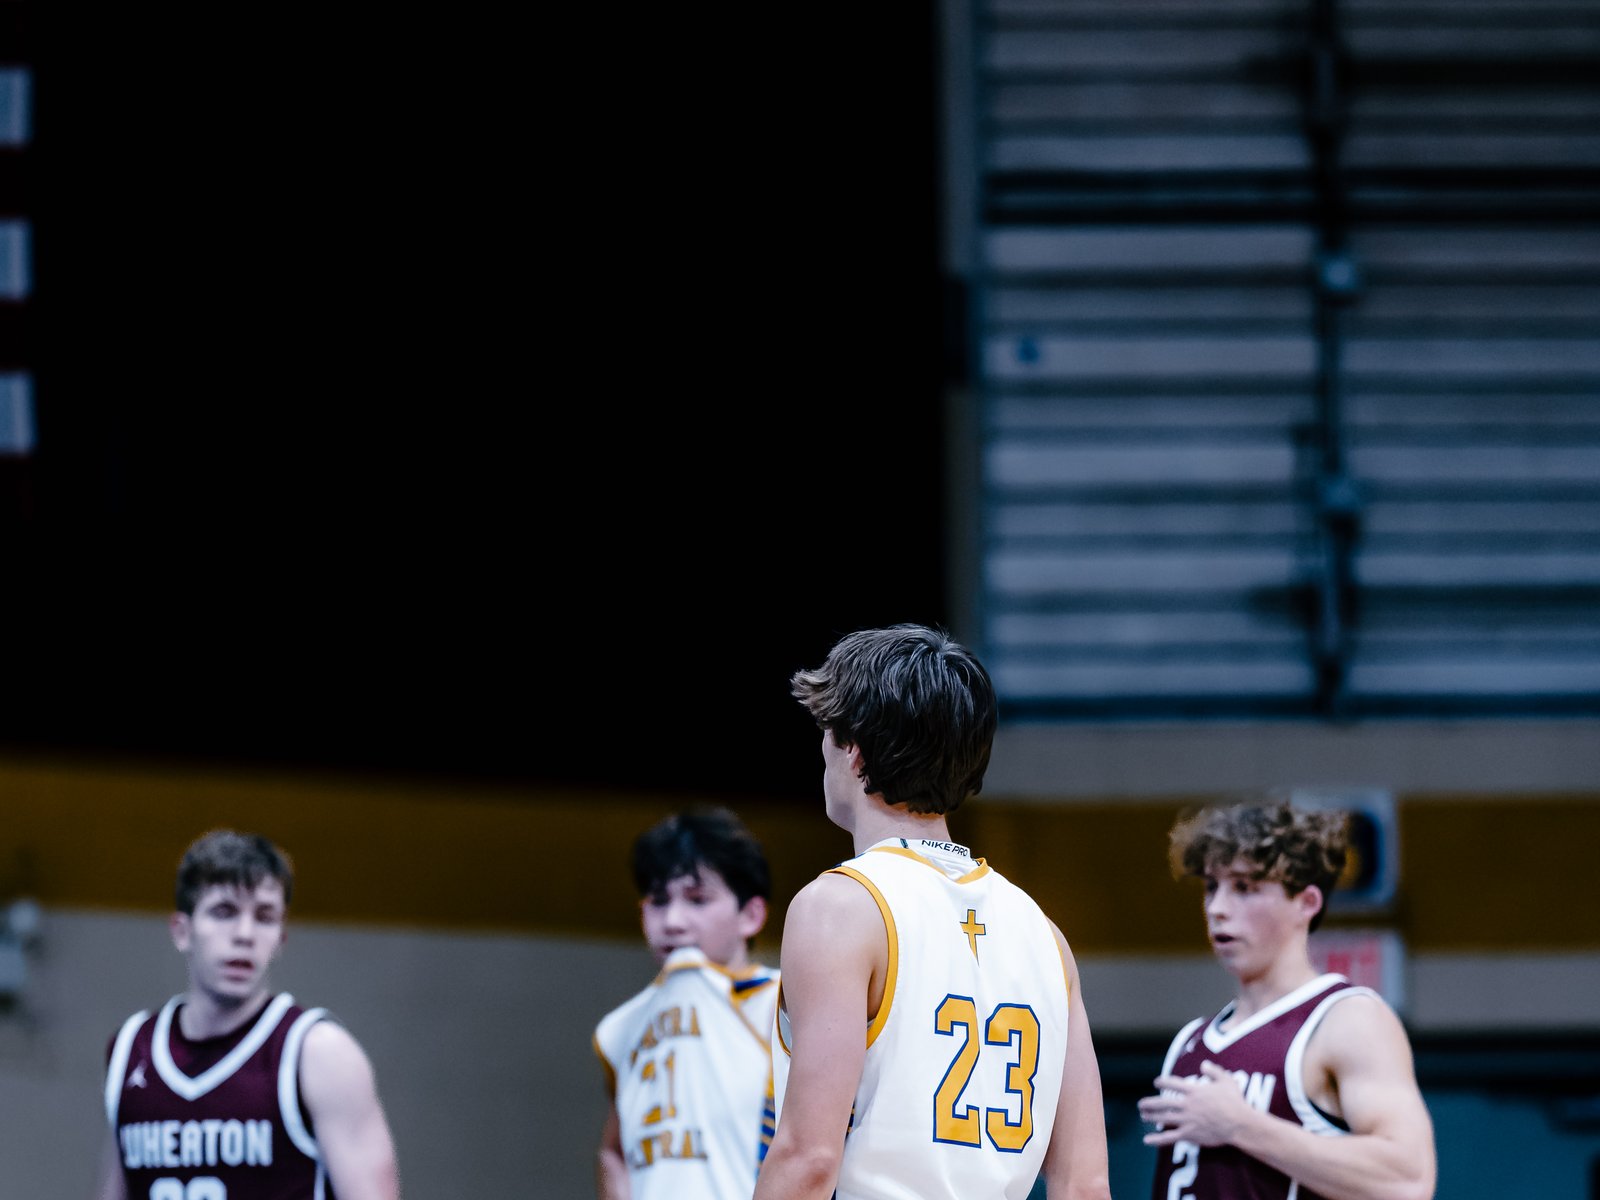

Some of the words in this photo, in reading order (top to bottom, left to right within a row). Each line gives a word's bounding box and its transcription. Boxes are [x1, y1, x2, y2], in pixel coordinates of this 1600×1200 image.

[921, 839, 952, 852] NIKE
[951, 845, 968, 857] PRO
[933, 993, 1041, 1153] 23
[120, 1119, 273, 1169] WHEATON
